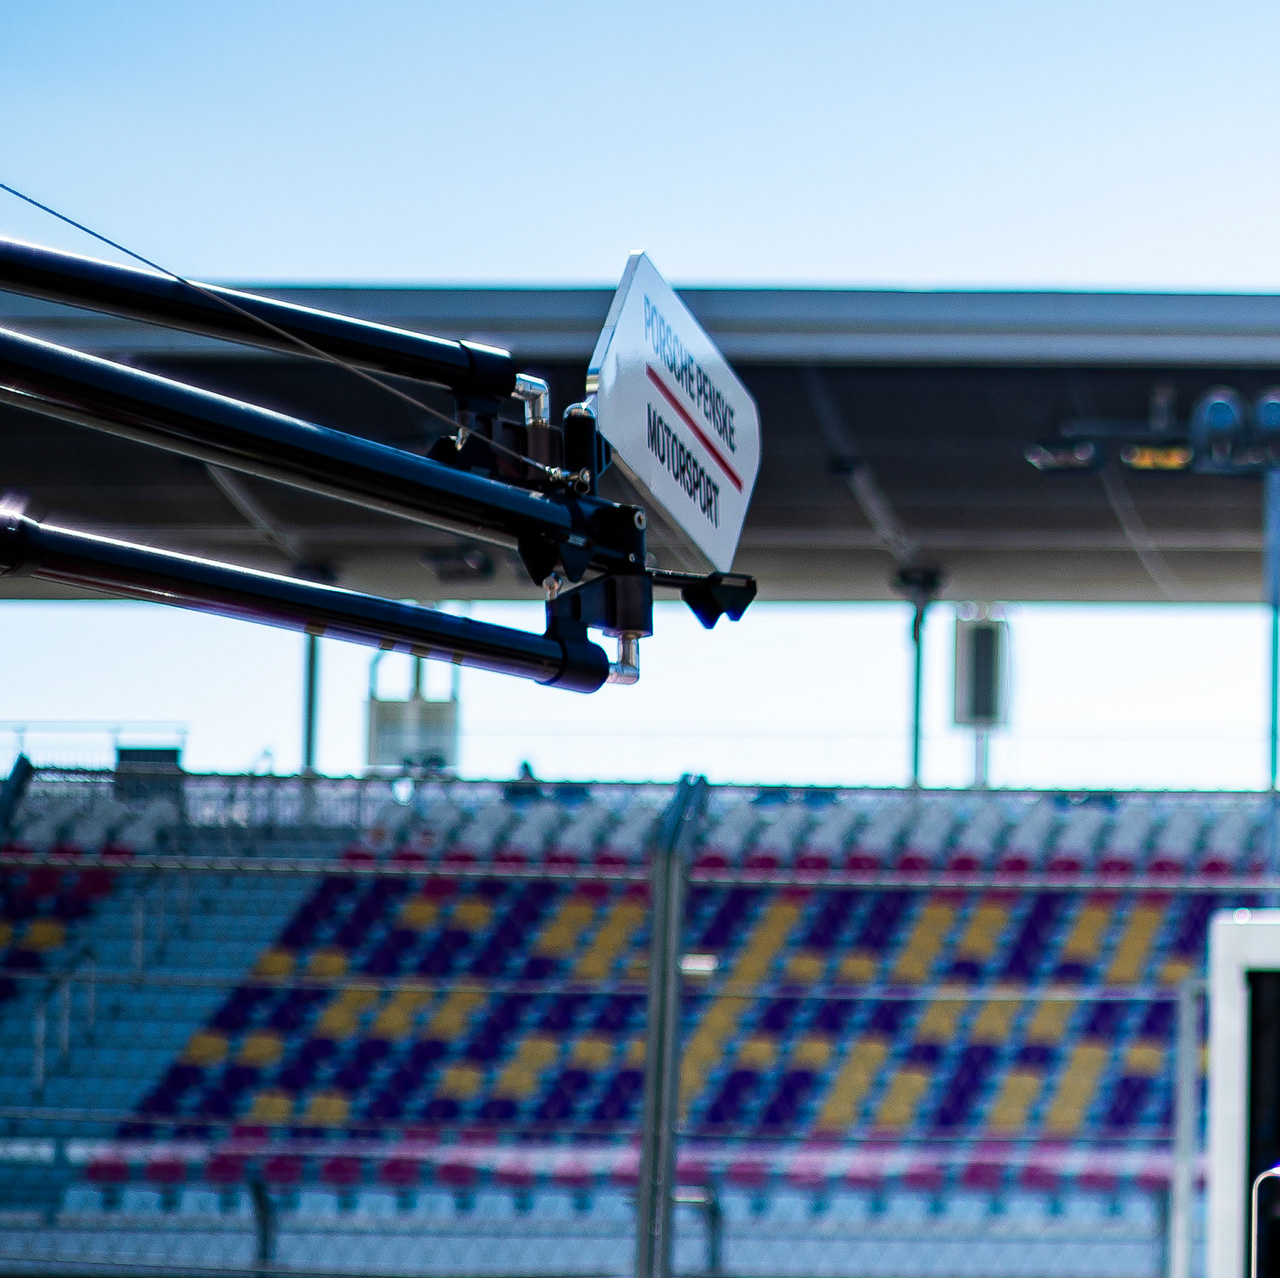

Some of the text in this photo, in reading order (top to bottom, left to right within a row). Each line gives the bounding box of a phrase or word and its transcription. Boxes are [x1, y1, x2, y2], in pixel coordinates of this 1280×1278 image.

[644, 293, 737, 454] PORSCHE PENSKE
[647, 402, 720, 529] MOTORSPORT
